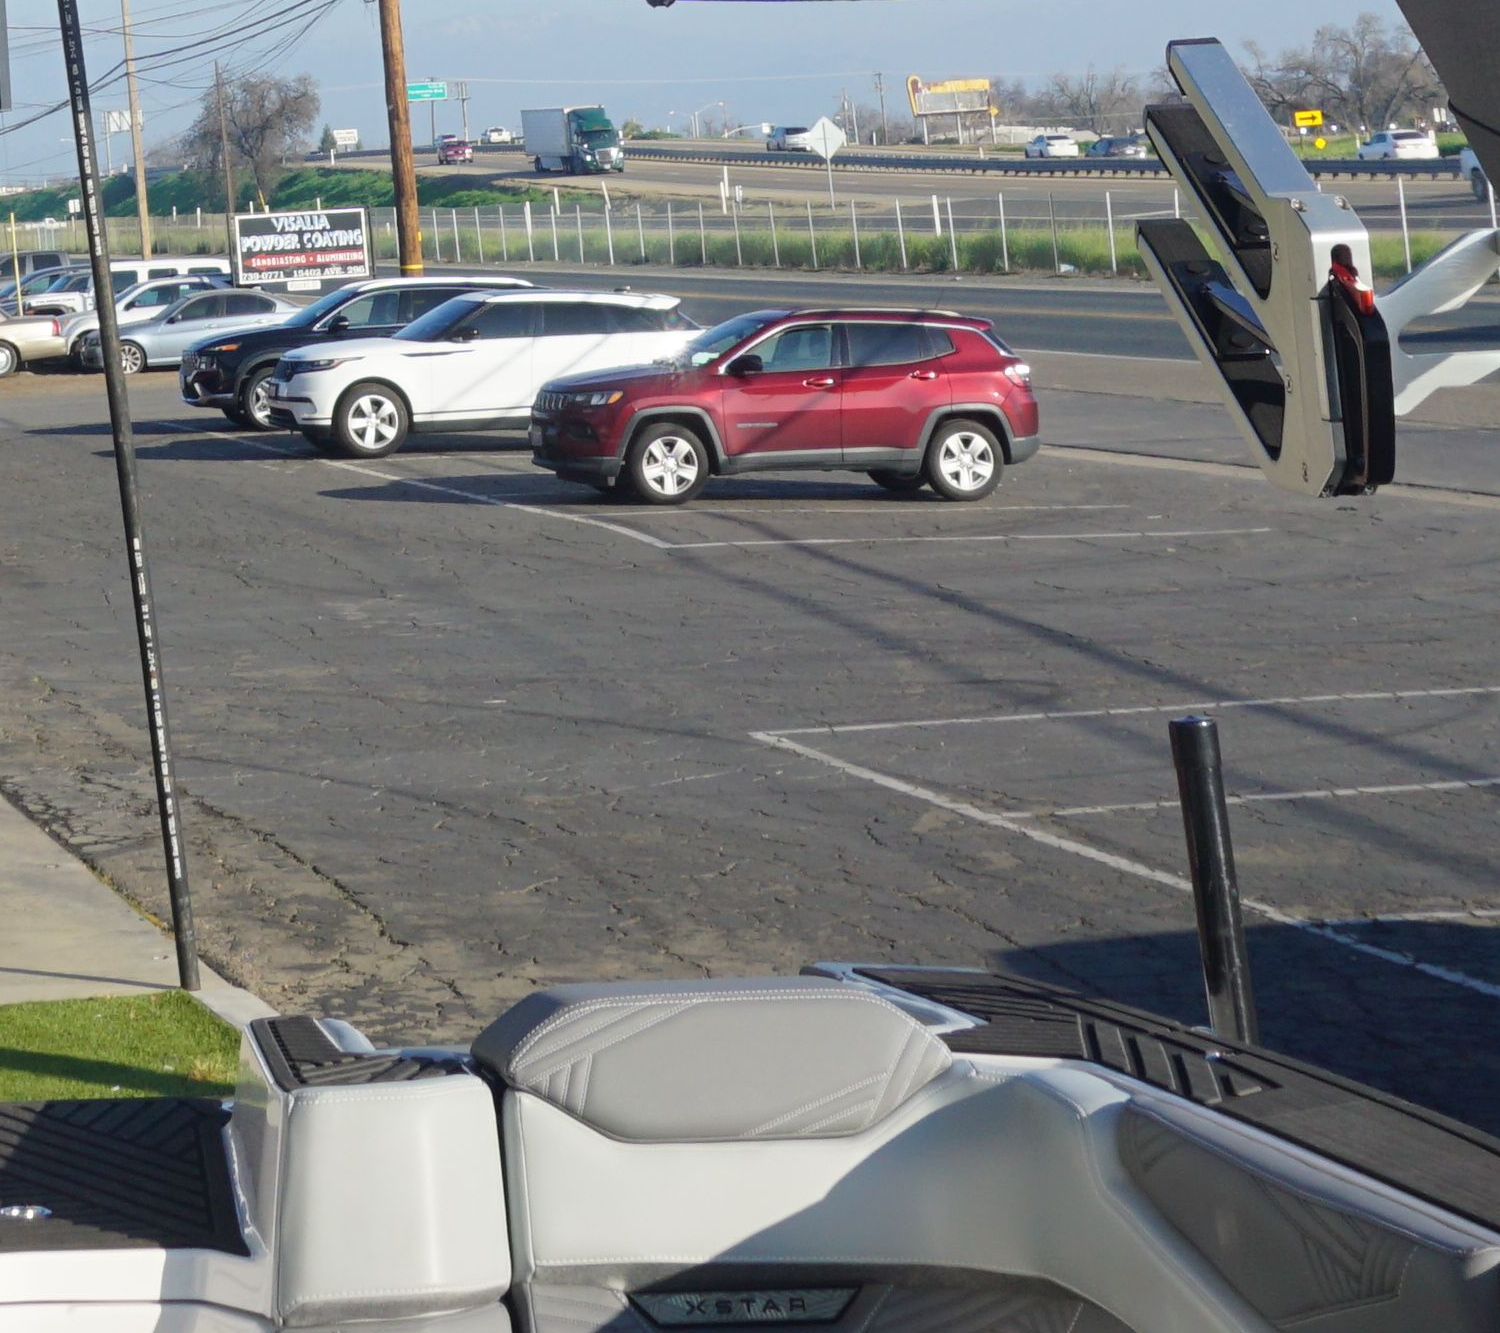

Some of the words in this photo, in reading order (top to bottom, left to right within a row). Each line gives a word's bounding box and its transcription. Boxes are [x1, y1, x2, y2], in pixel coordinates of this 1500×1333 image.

[271, 215, 331, 232] VISALIA
[241, 234, 301, 252] POWDER
[303, 229, 363, 249] COATING
